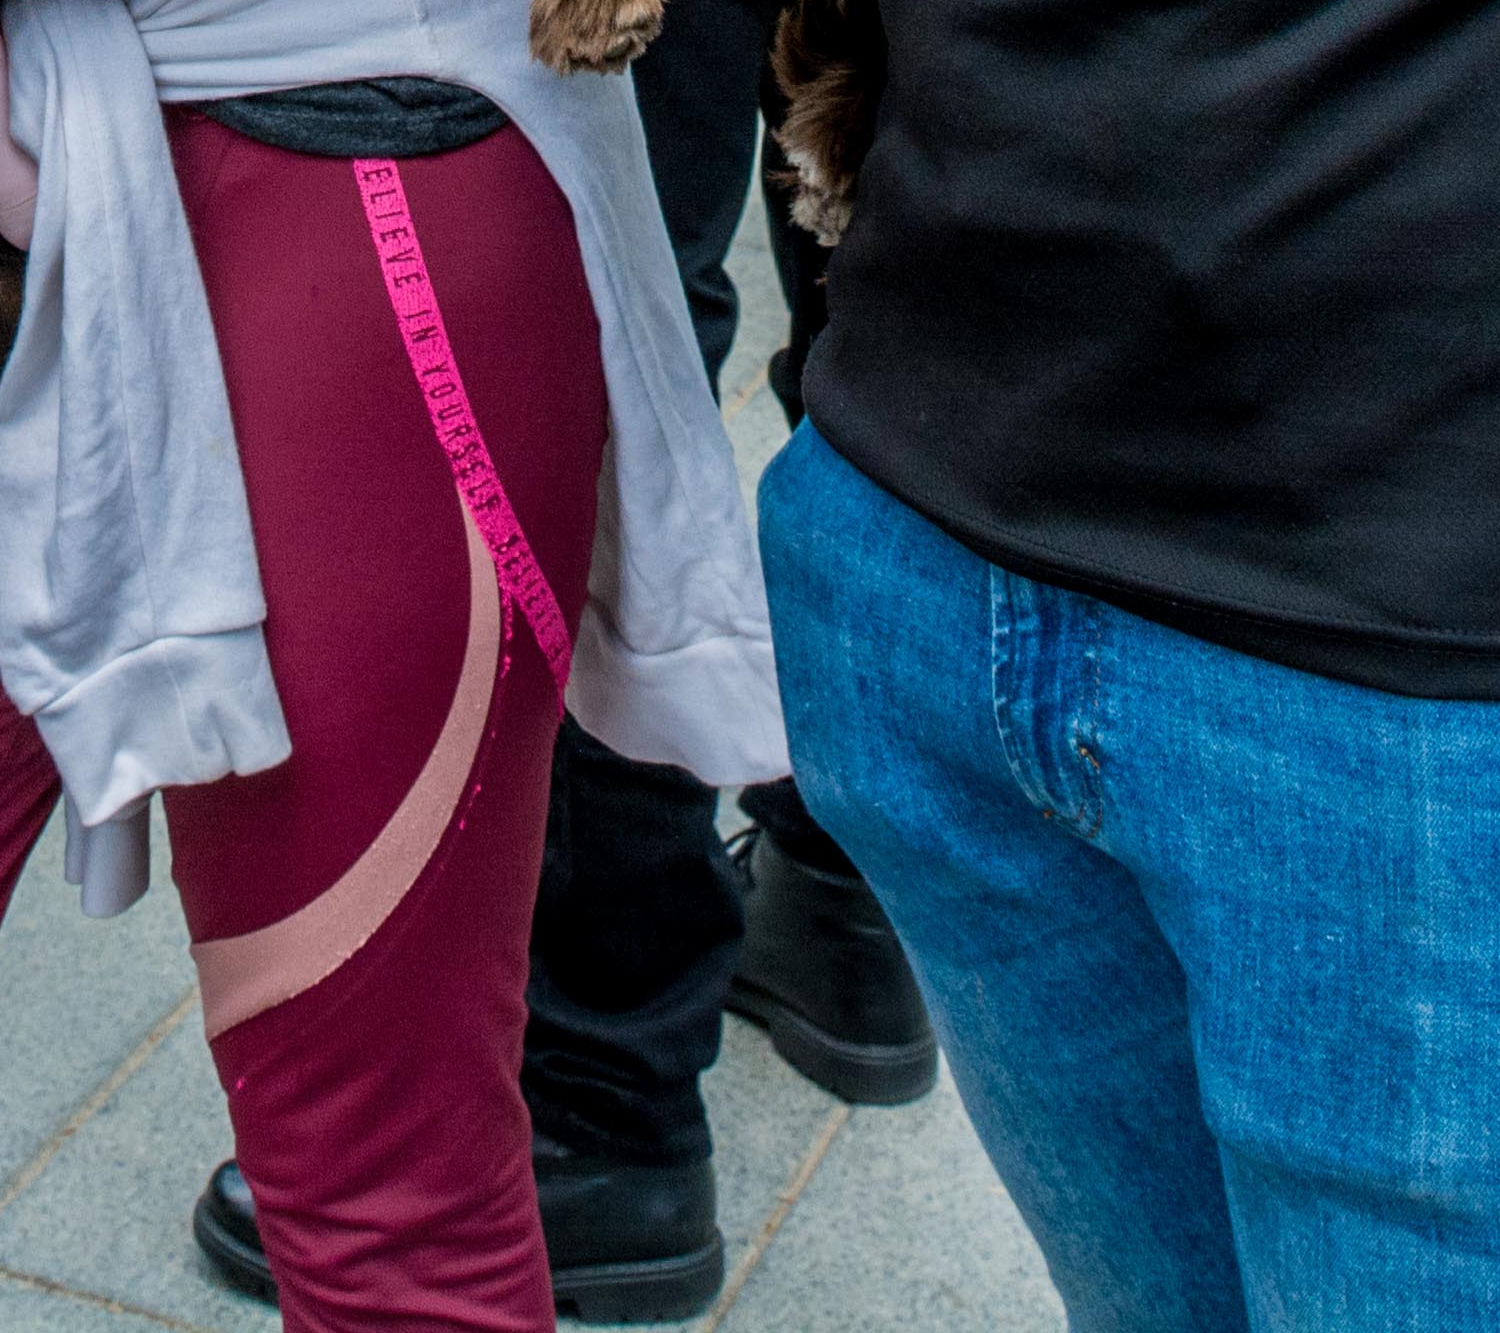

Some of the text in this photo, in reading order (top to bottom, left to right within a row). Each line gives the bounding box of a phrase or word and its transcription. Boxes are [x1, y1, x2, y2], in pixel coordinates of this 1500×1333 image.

[362, 166, 424, 289] ELIEVE
[405, 308, 439, 345] IN
[422, 360, 500, 511] YOURSELF
